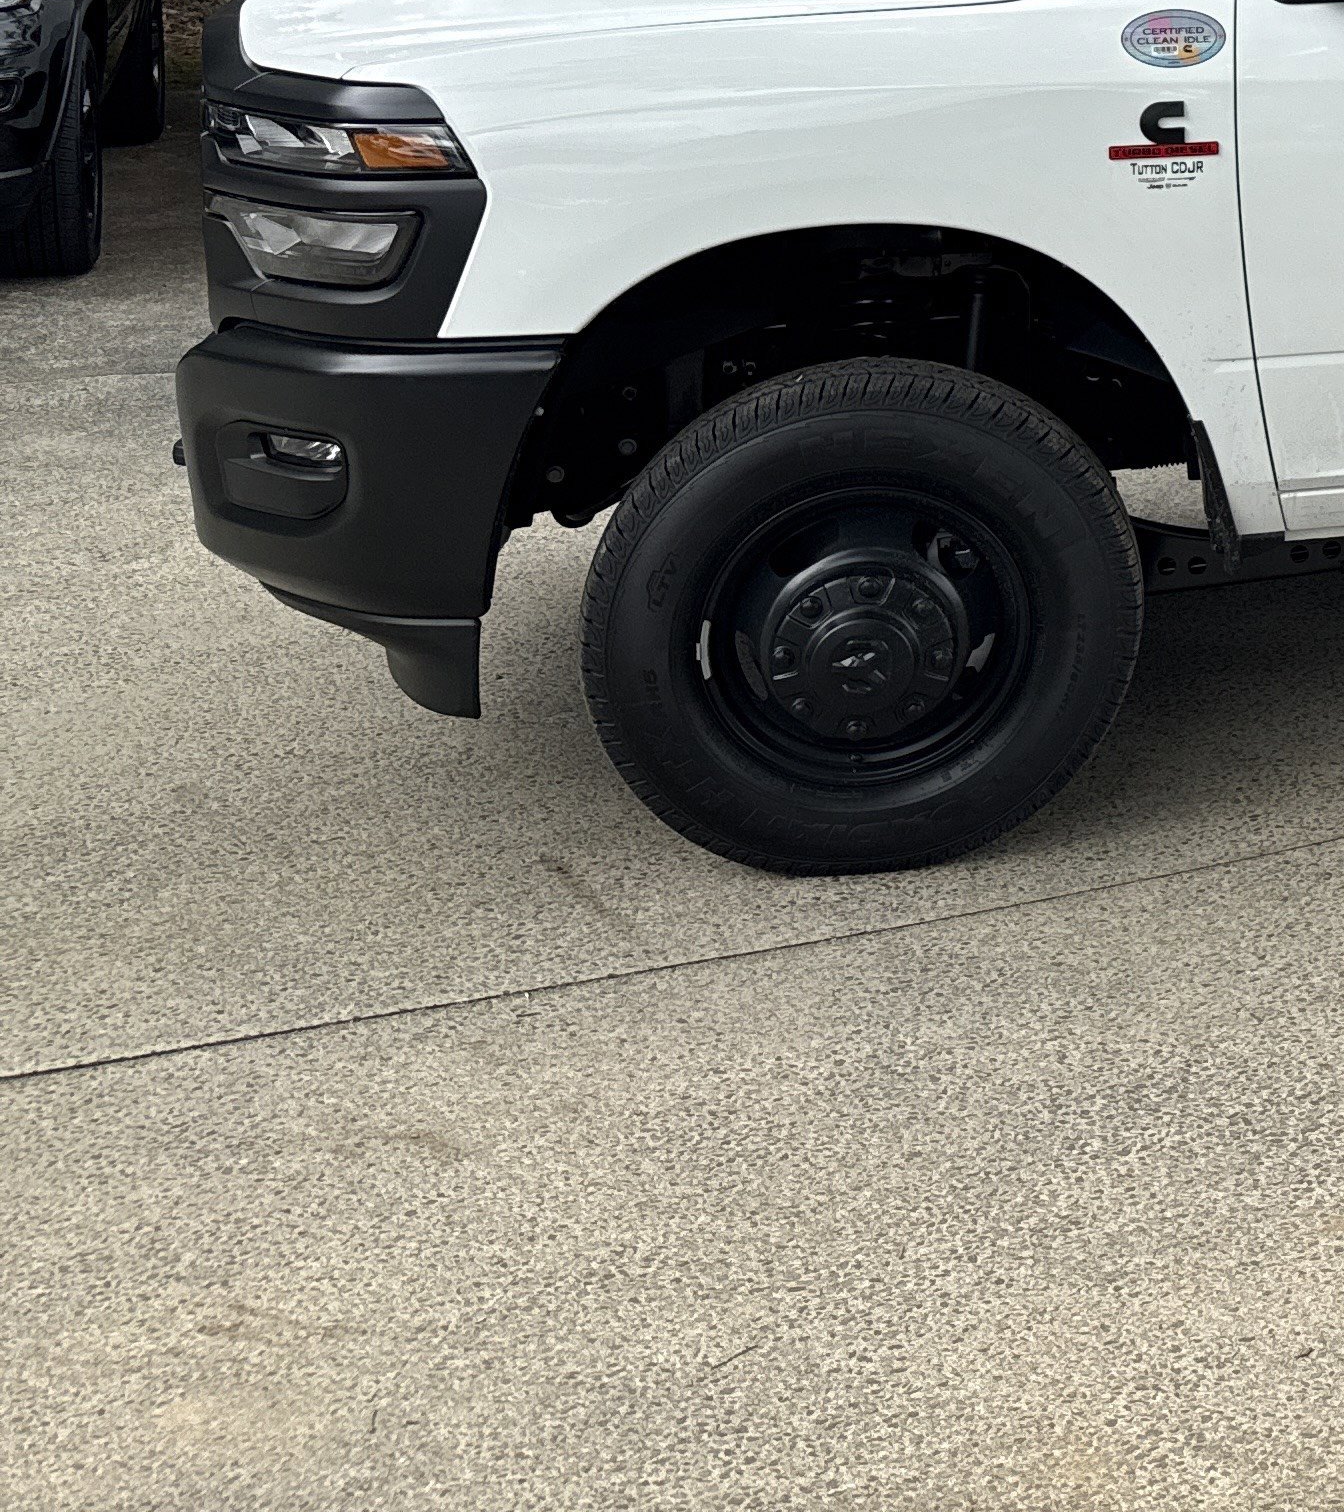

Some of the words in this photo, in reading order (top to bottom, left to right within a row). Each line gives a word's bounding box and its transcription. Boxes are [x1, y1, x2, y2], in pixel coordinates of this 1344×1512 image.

[1142, 26, 1205, 36] CERTIFIED
[1136, 36, 1179, 46] CLEAN
[1183, 35, 1212, 44] IDLE
[1171, 160, 1204, 174] CDJR
